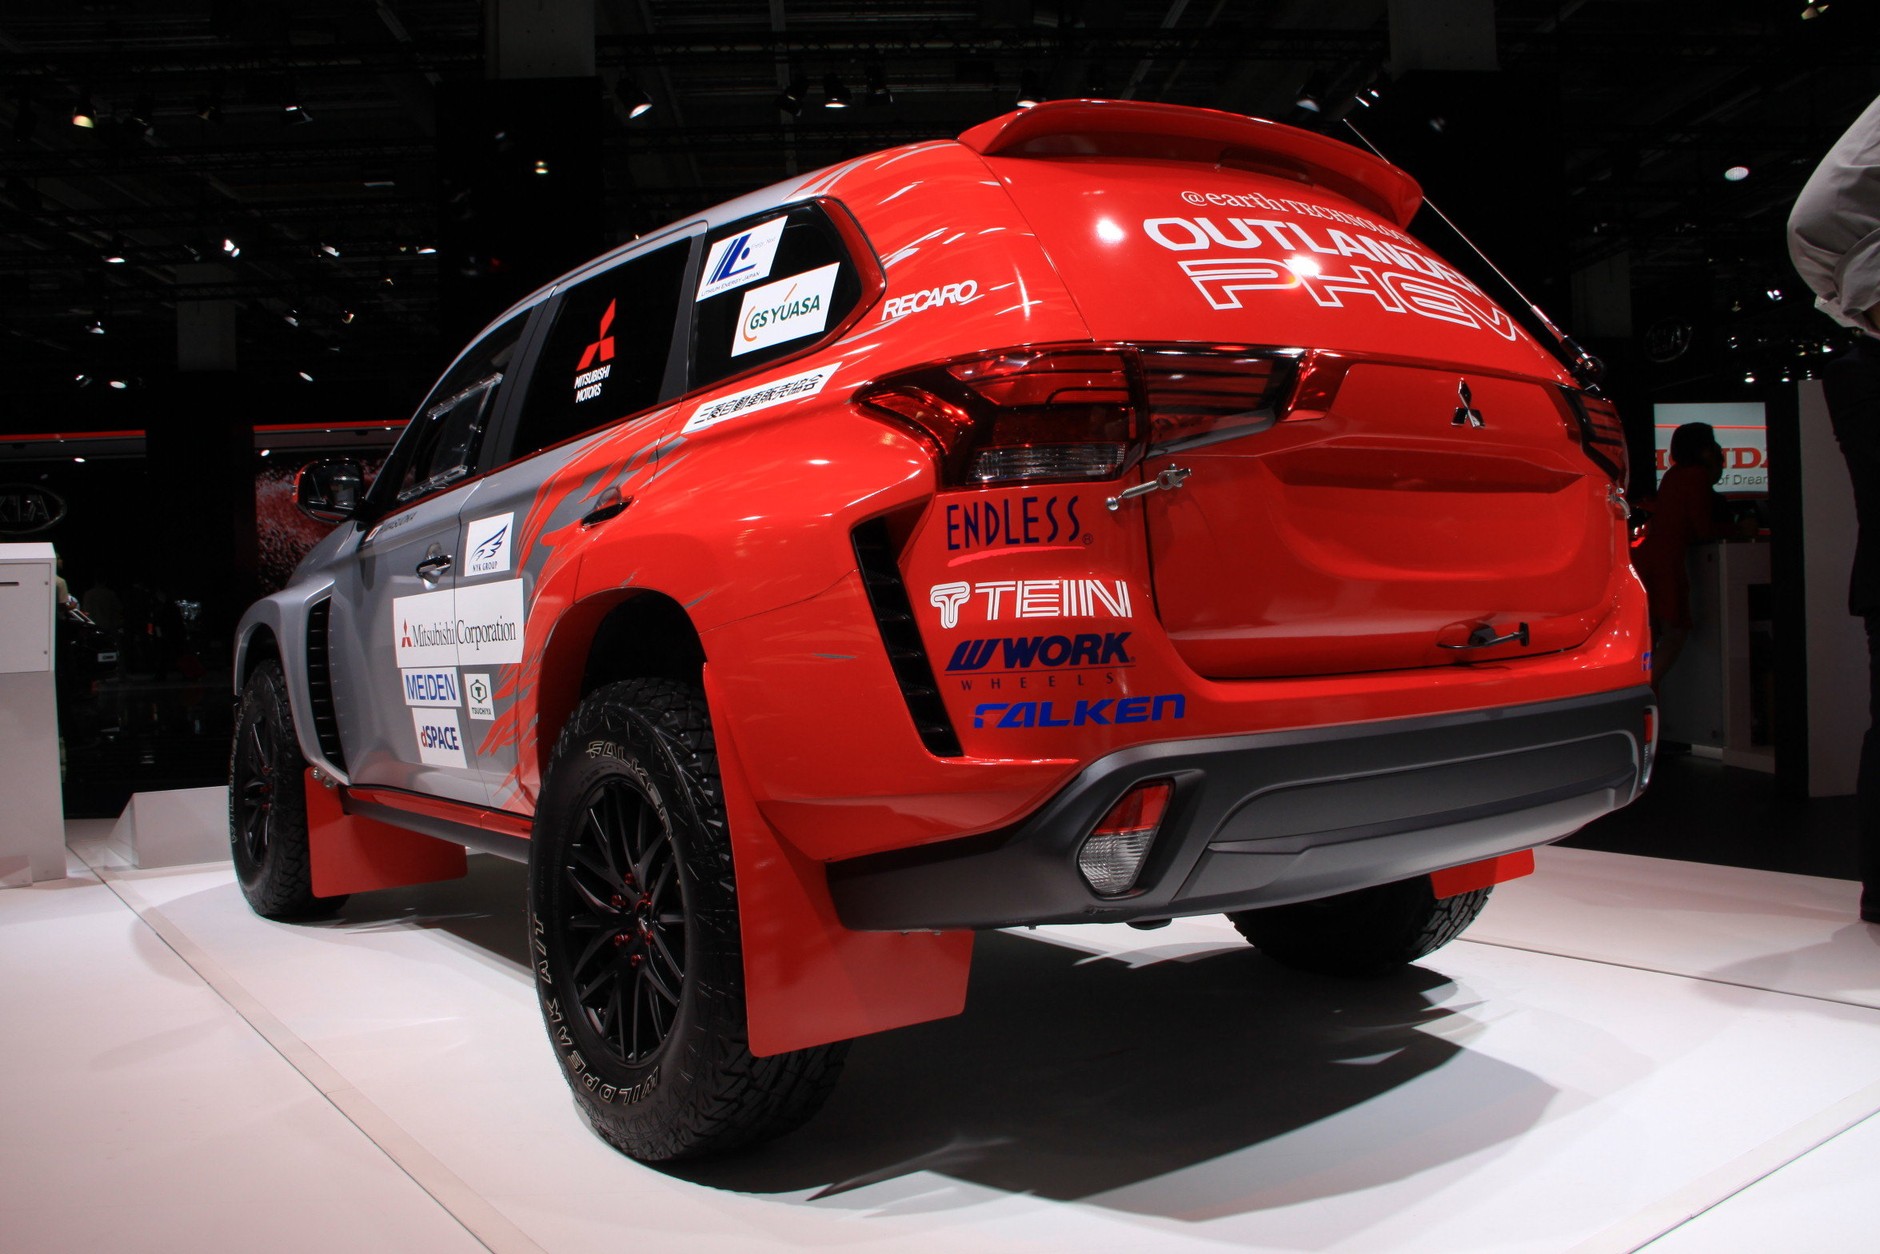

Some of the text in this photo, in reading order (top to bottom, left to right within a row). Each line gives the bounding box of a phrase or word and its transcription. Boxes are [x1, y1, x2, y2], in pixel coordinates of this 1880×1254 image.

[1181, 190, 1421, 249] @earth TECHNOLOGY
[721, 278, 741, 289] ENERGY
[742, 271, 761, 282] JAPAN
[1143, 217, 1498, 308] OUTLANDER
[749, 294, 821, 331] GS YUASA
[881, 279, 978, 321] RECARO
[1177, 258, 1523, 342] PHEV
[573, 364, 611, 390] MITSUBISHI
[575, 382, 602, 404] MOTORS
[946, 495, 1081, 551] ENDLESS
[472, 560, 498, 573] NYK GROUP
[974, 579, 1133, 621] TEIN
[412, 615, 517, 651] Mitsubishi Corporation
[1003, 632, 1133, 670] WORK
[405, 673, 457, 702] MEIDEN
[961, 671, 1114, 691] WHEELS
[471, 706, 492, 716] TSUCHIYA
[973, 692, 1186, 729] FALKEN
[420, 725, 460, 751] dSPACE
[546, 997, 660, 1105] WILDPEAK
